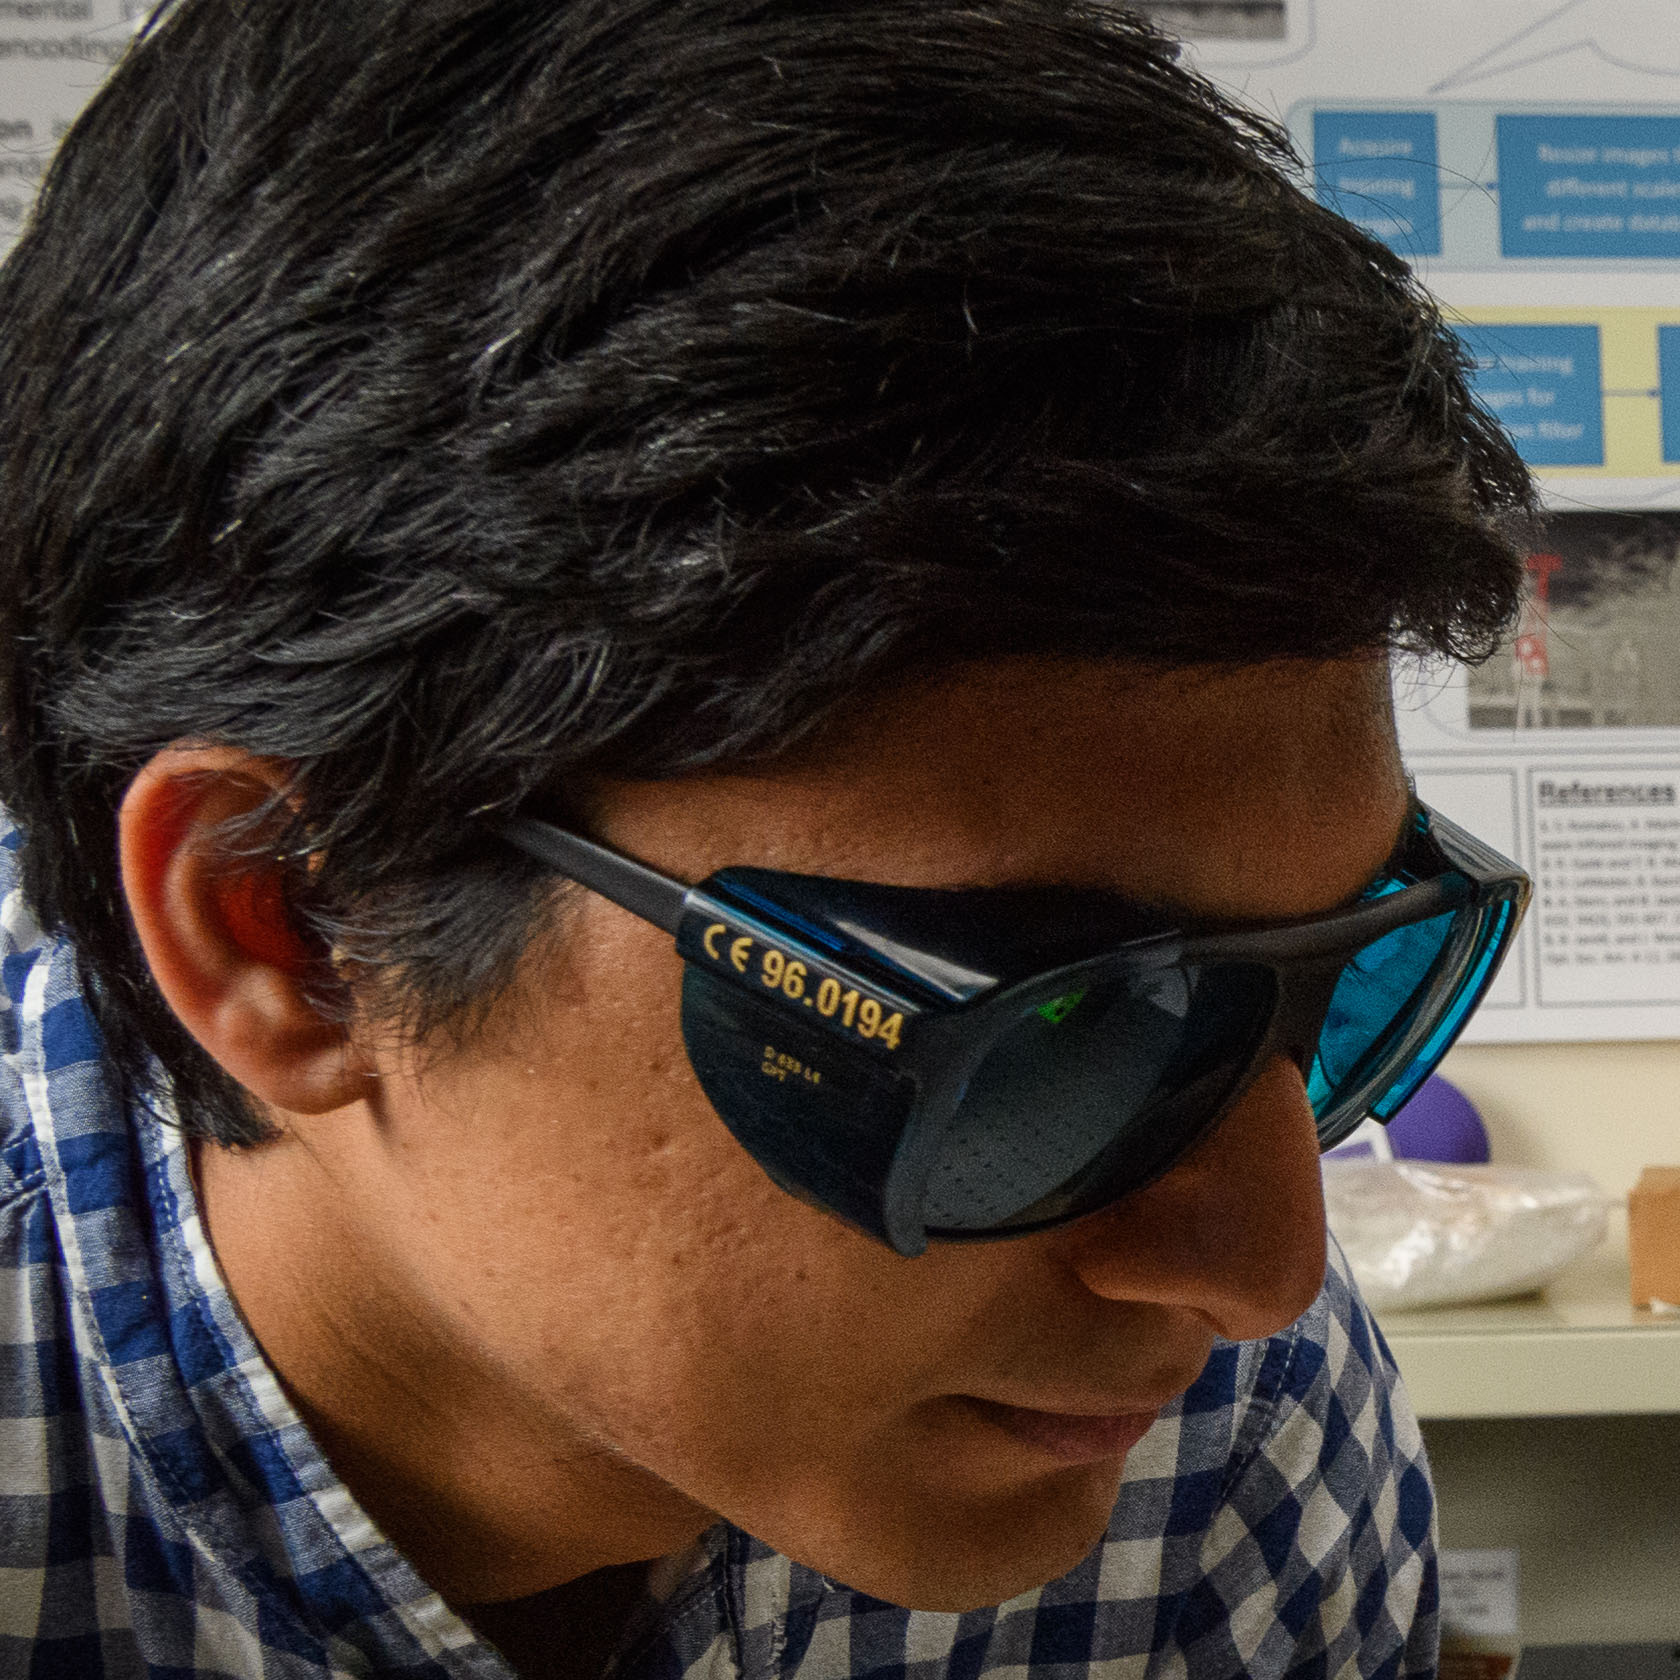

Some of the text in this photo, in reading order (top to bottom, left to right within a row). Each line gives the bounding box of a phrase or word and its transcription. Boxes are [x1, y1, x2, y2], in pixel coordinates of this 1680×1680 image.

[1538, 143, 1597, 163] Resize
[1603, 146, 1669, 168] images
[1546, 178, 1627, 198] different
[1523, 214, 1559, 232] and
[1564, 215, 1624, 233] create
[1537, 779, 1677, 806] References
[702, 923, 905, 1051] CE 96.0194
